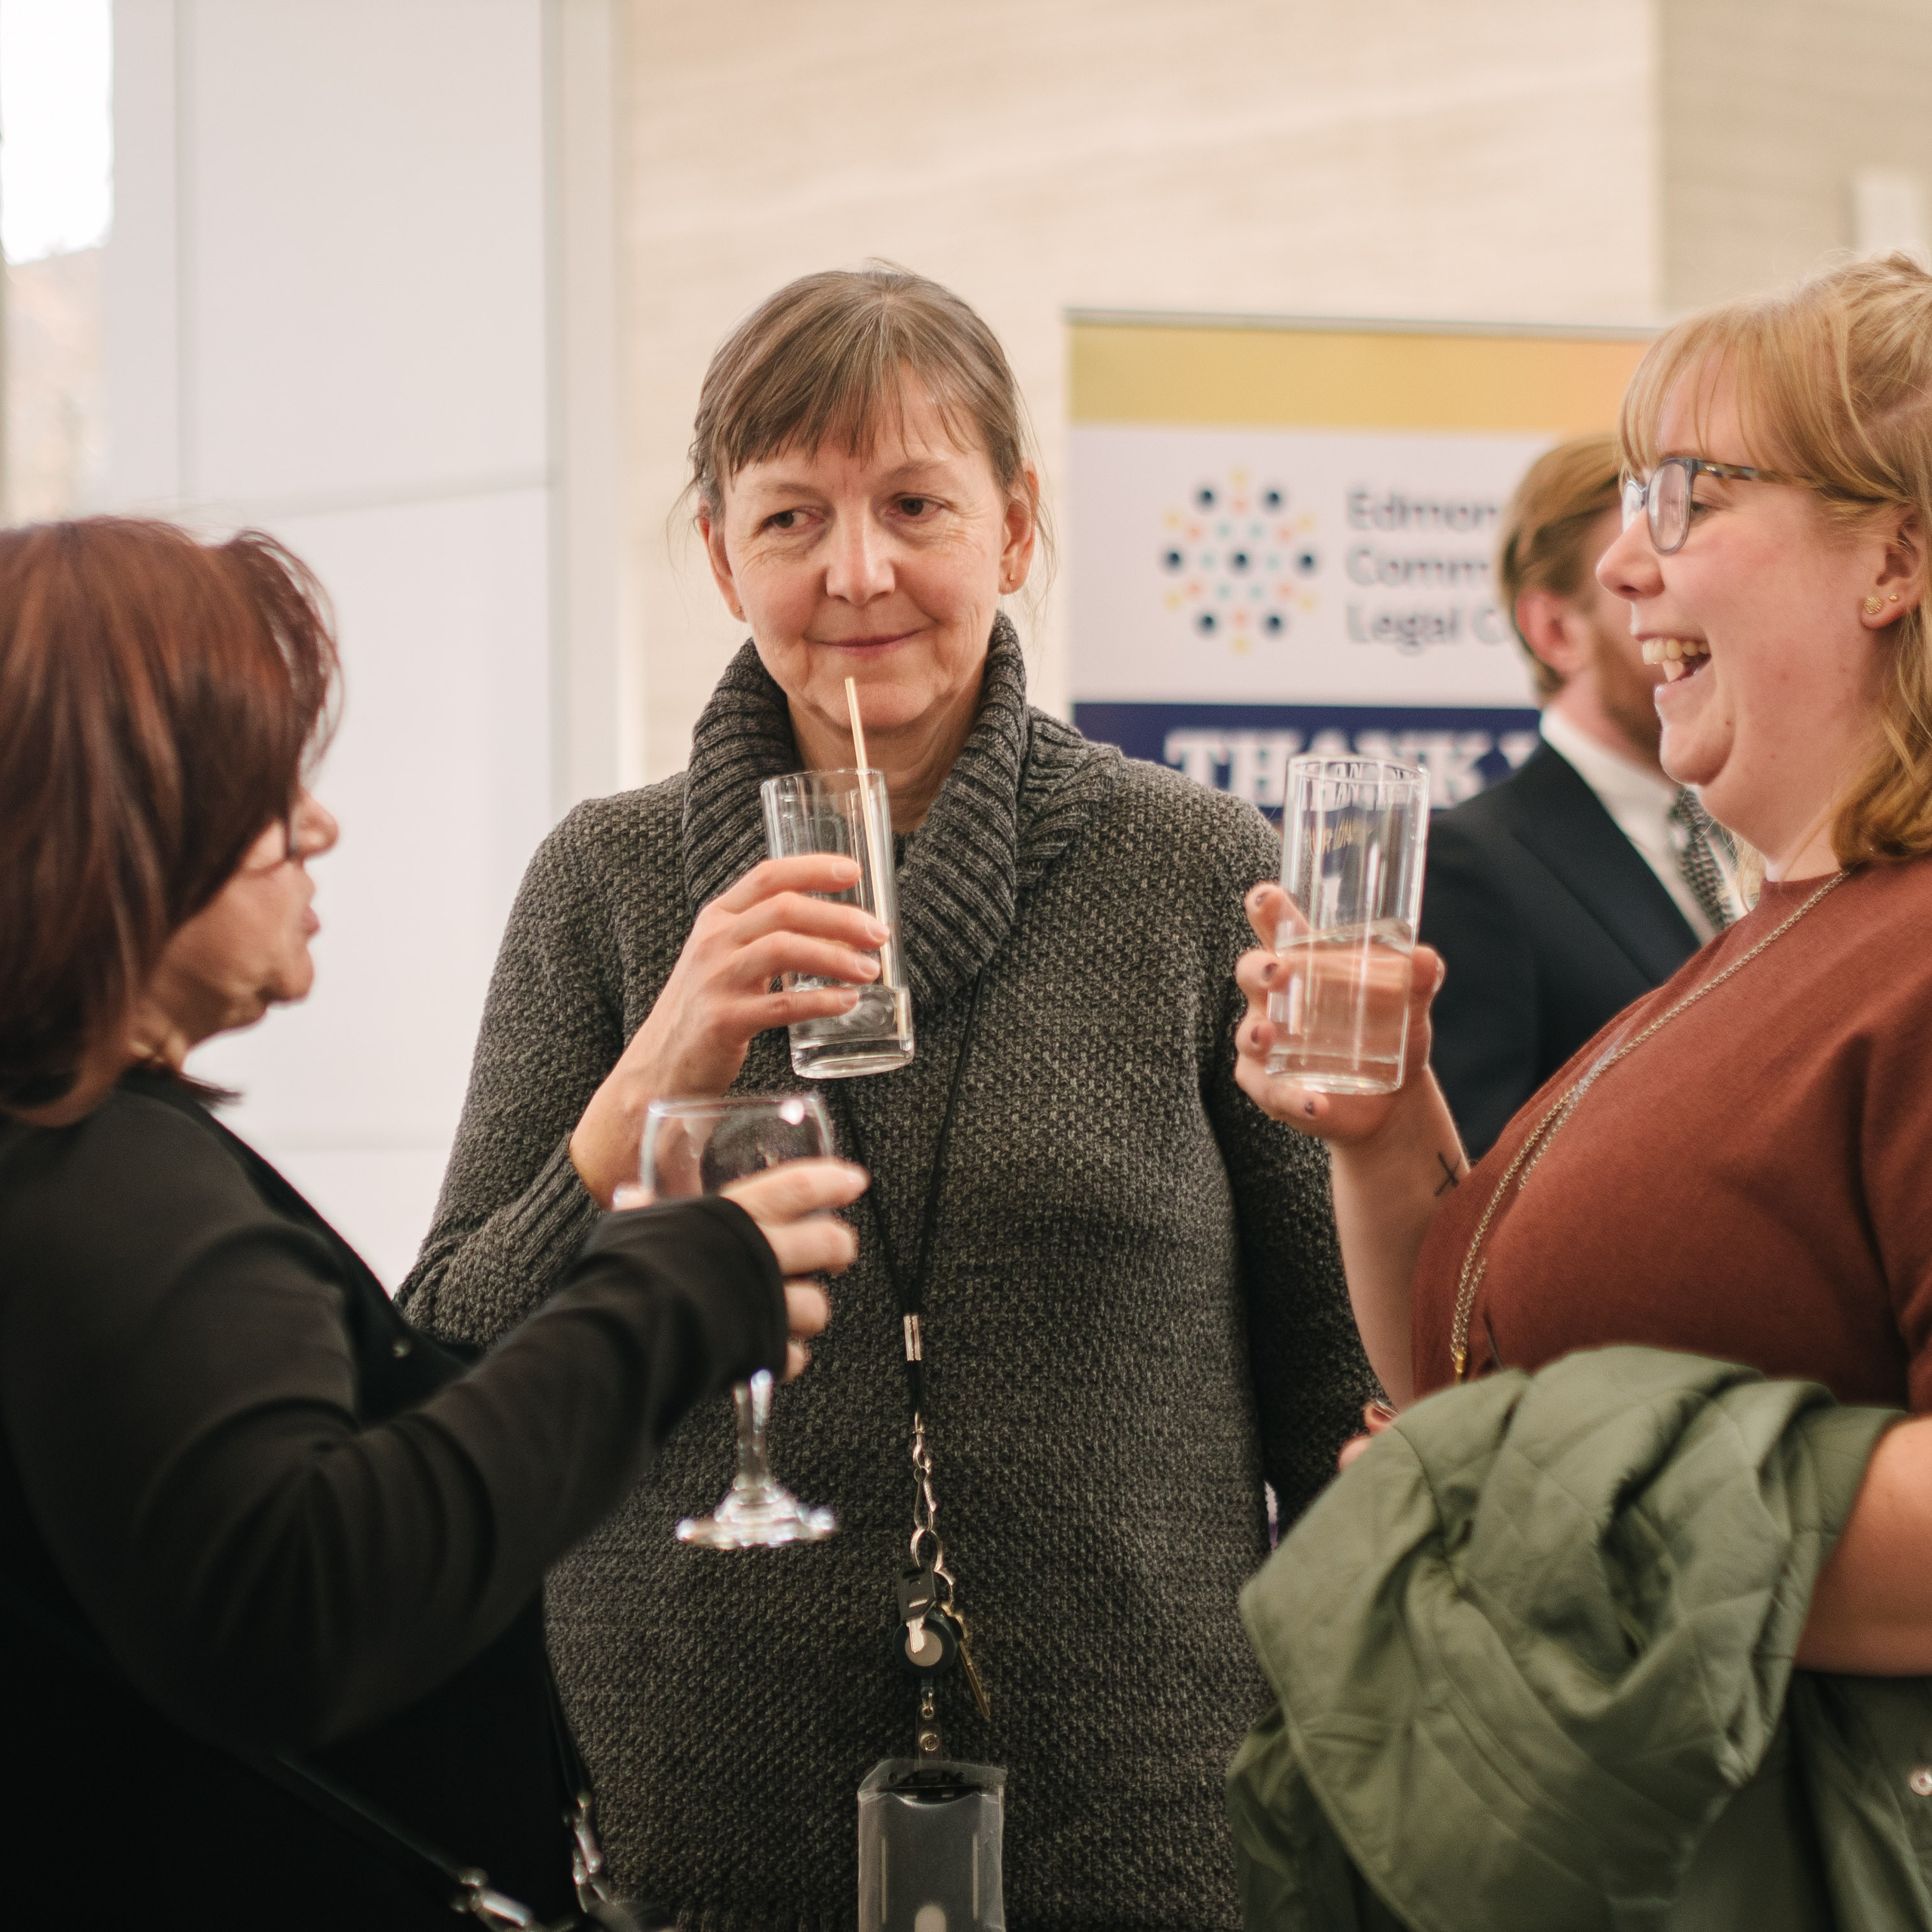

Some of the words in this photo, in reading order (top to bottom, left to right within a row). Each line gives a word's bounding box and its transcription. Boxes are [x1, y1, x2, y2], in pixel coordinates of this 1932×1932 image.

[1347, 487, 1505, 531] Edmon
[1346, 546, 1498, 586] Comm
[1347, 602, 1461, 656] Legal
